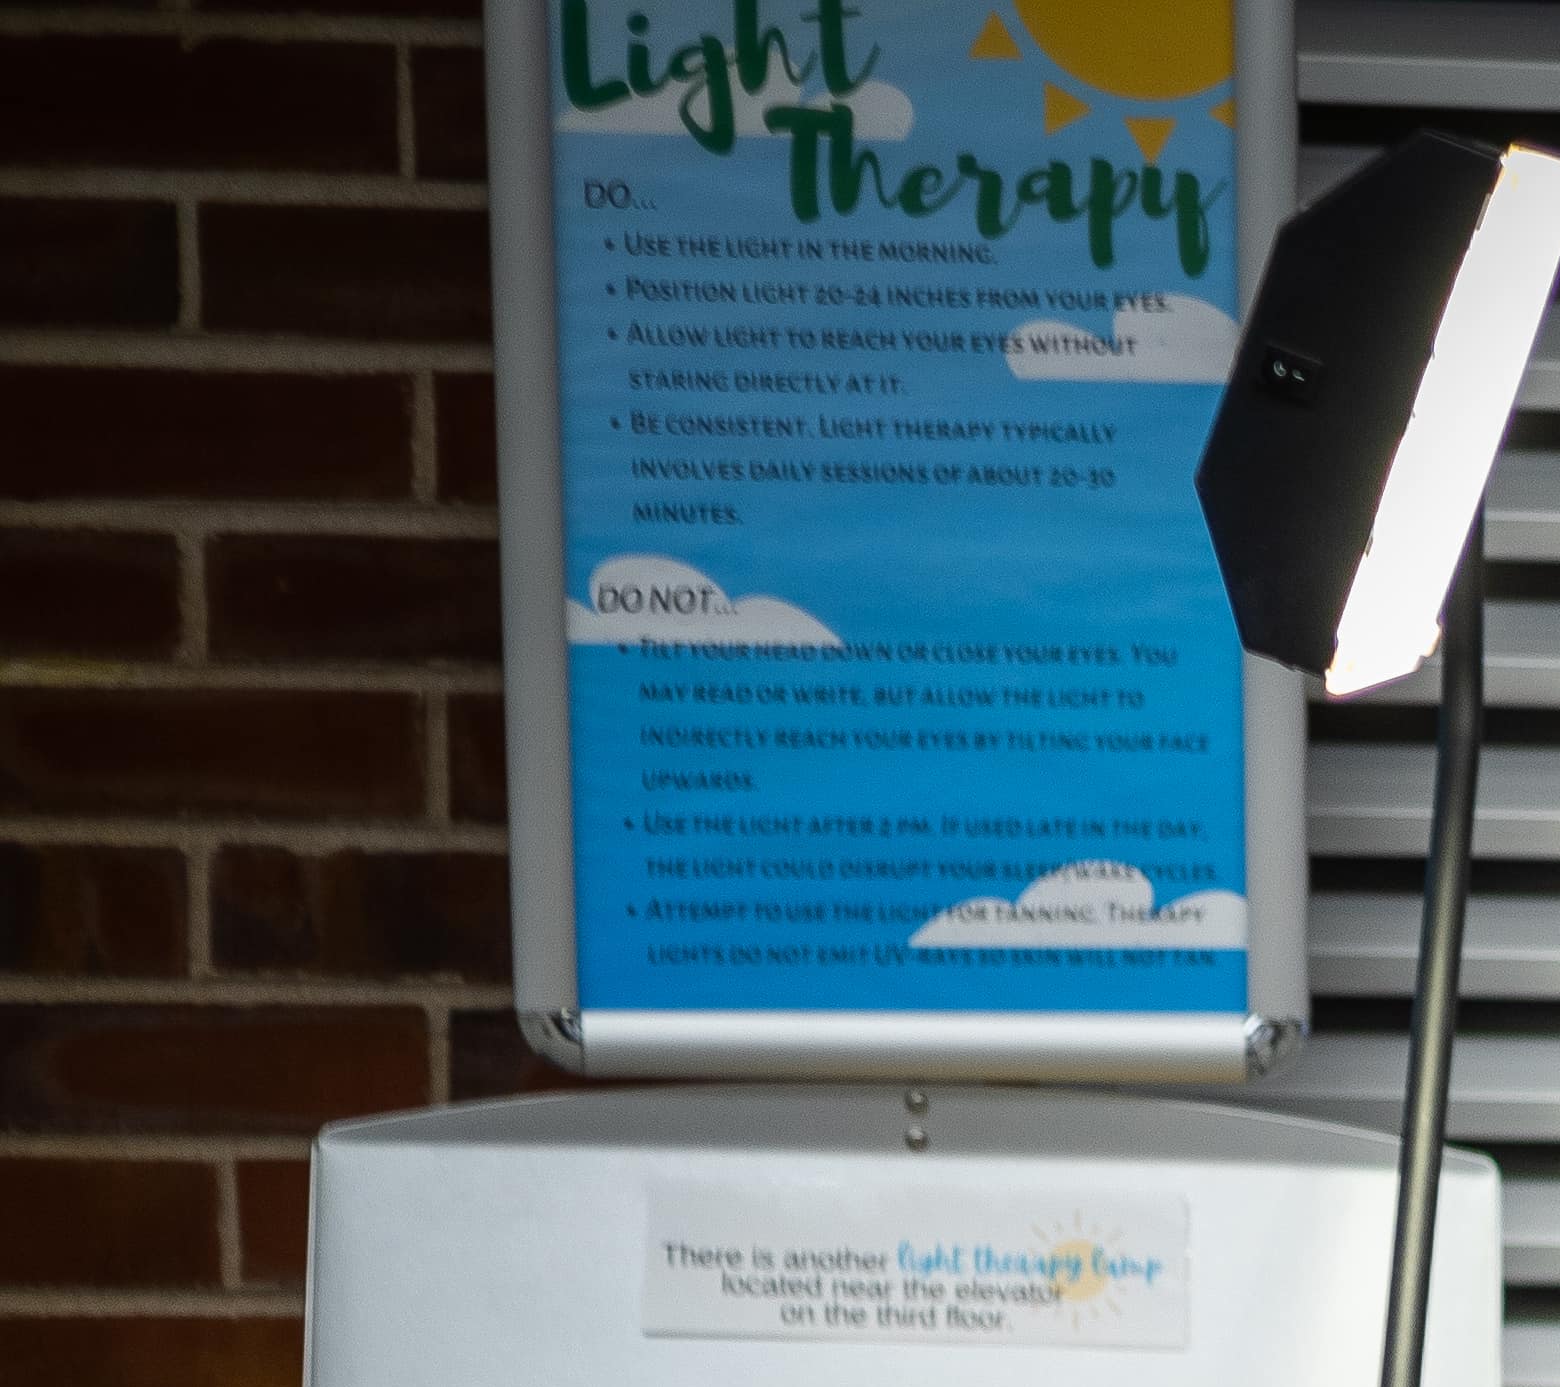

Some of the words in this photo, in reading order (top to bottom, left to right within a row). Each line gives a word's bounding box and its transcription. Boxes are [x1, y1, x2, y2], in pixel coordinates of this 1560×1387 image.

[561, 0, 881, 156] Light
[583, 177, 657, 210] DO...
[763, 103, 1227, 278] Therapy
[624, 231, 676, 257] USE
[676, 237, 723, 259] THE
[725, 237, 792, 260] LIGHT
[798, 238, 824, 260] IN
[830, 239, 874, 262] THE
[878, 242, 998, 265] MORNING.
[625, 275, 736, 303] POSITION
[743, 282, 808, 305] LIGHT
[887, 286, 971, 308] INCHES
[976, 288, 1040, 310] FROM
[1045, 290, 1109, 312] YOUR
[1113, 291, 1173, 314] EYES.
[628, 319, 708, 347] ALLOW
[714, 325, 780, 349] LIGHT
[786, 326, 817, 349] TO
[821, 328, 897, 352] REACH
[902, 330, 965, 353] YOUR
[970, 332, 1024, 355] EYES
[1030, 333, 1138, 357] WITHOUT
[628, 369, 729, 392] STARING
[733, 371, 841, 395] DIRECTLY
[845, 373, 873, 395] AT
[631, 409, 661, 435] BE
[818, 414, 886, 439] LIGHT
[893, 418, 994, 442] THERAPY
[1001, 420, 1117, 445] TYPICALLY
[631, 457, 743, 481] INVOLVES
[749, 460, 815, 483] DAILY
[821, 460, 929, 485] SESSIONS
[933, 463, 962, 485] OF
[967, 464, 1041, 487] ABOUT
[633, 501, 743, 525] MINUTES.
[598, 582, 642, 615] DO
[649, 584, 738, 616] NOT...
[662, 1240, 744, 1271] There
[750, 1245, 775, 1271] is
[783, 1246, 889, 1273] another
[896, 1238, 962, 1278] light
[973, 1244, 1084, 1282] therapy
[721, 1271, 822, 1298] located
[832, 1275, 895, 1300] near
[902, 1274, 946, 1301] the
[954, 1277, 1064, 1304] elevator
[780, 1304, 815, 1326] on
[824, 1301, 867, 1328] the
[876, 1302, 937, 1330] third
[945, 1304, 1013, 1331] floor.
